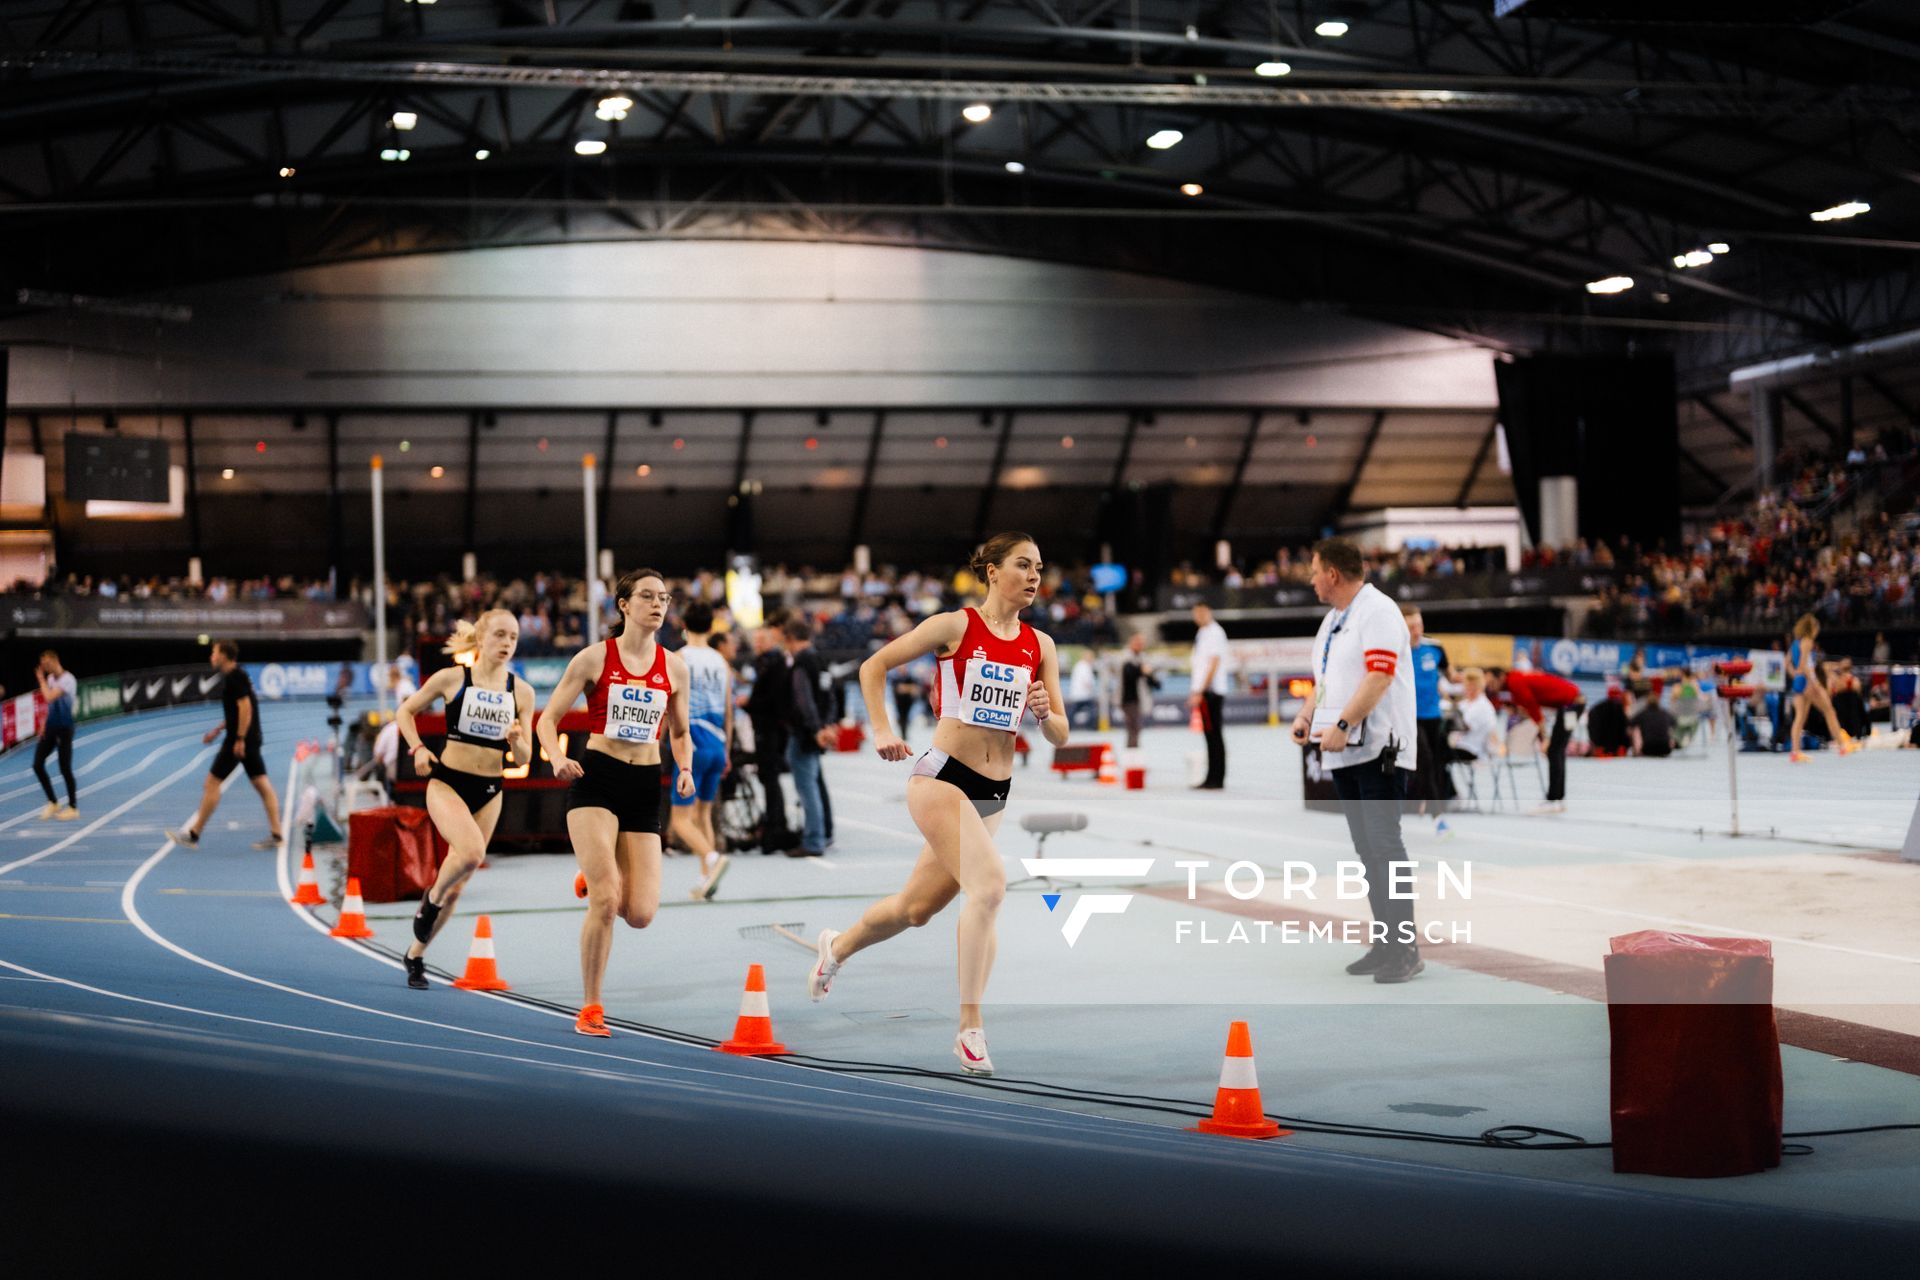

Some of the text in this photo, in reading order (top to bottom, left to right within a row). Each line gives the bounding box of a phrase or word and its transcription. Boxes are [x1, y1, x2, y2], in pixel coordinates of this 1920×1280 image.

[981, 663, 1015, 683] GLS
[476, 691, 503, 704] GLS
[622, 688, 653, 703] GLS
[970, 683, 1022, 709] BOTHE
[466, 704, 511, 725] LANKES
[612, 704, 661, 725] R.FIEDLER
[990, 712, 1011, 722] PLAN
